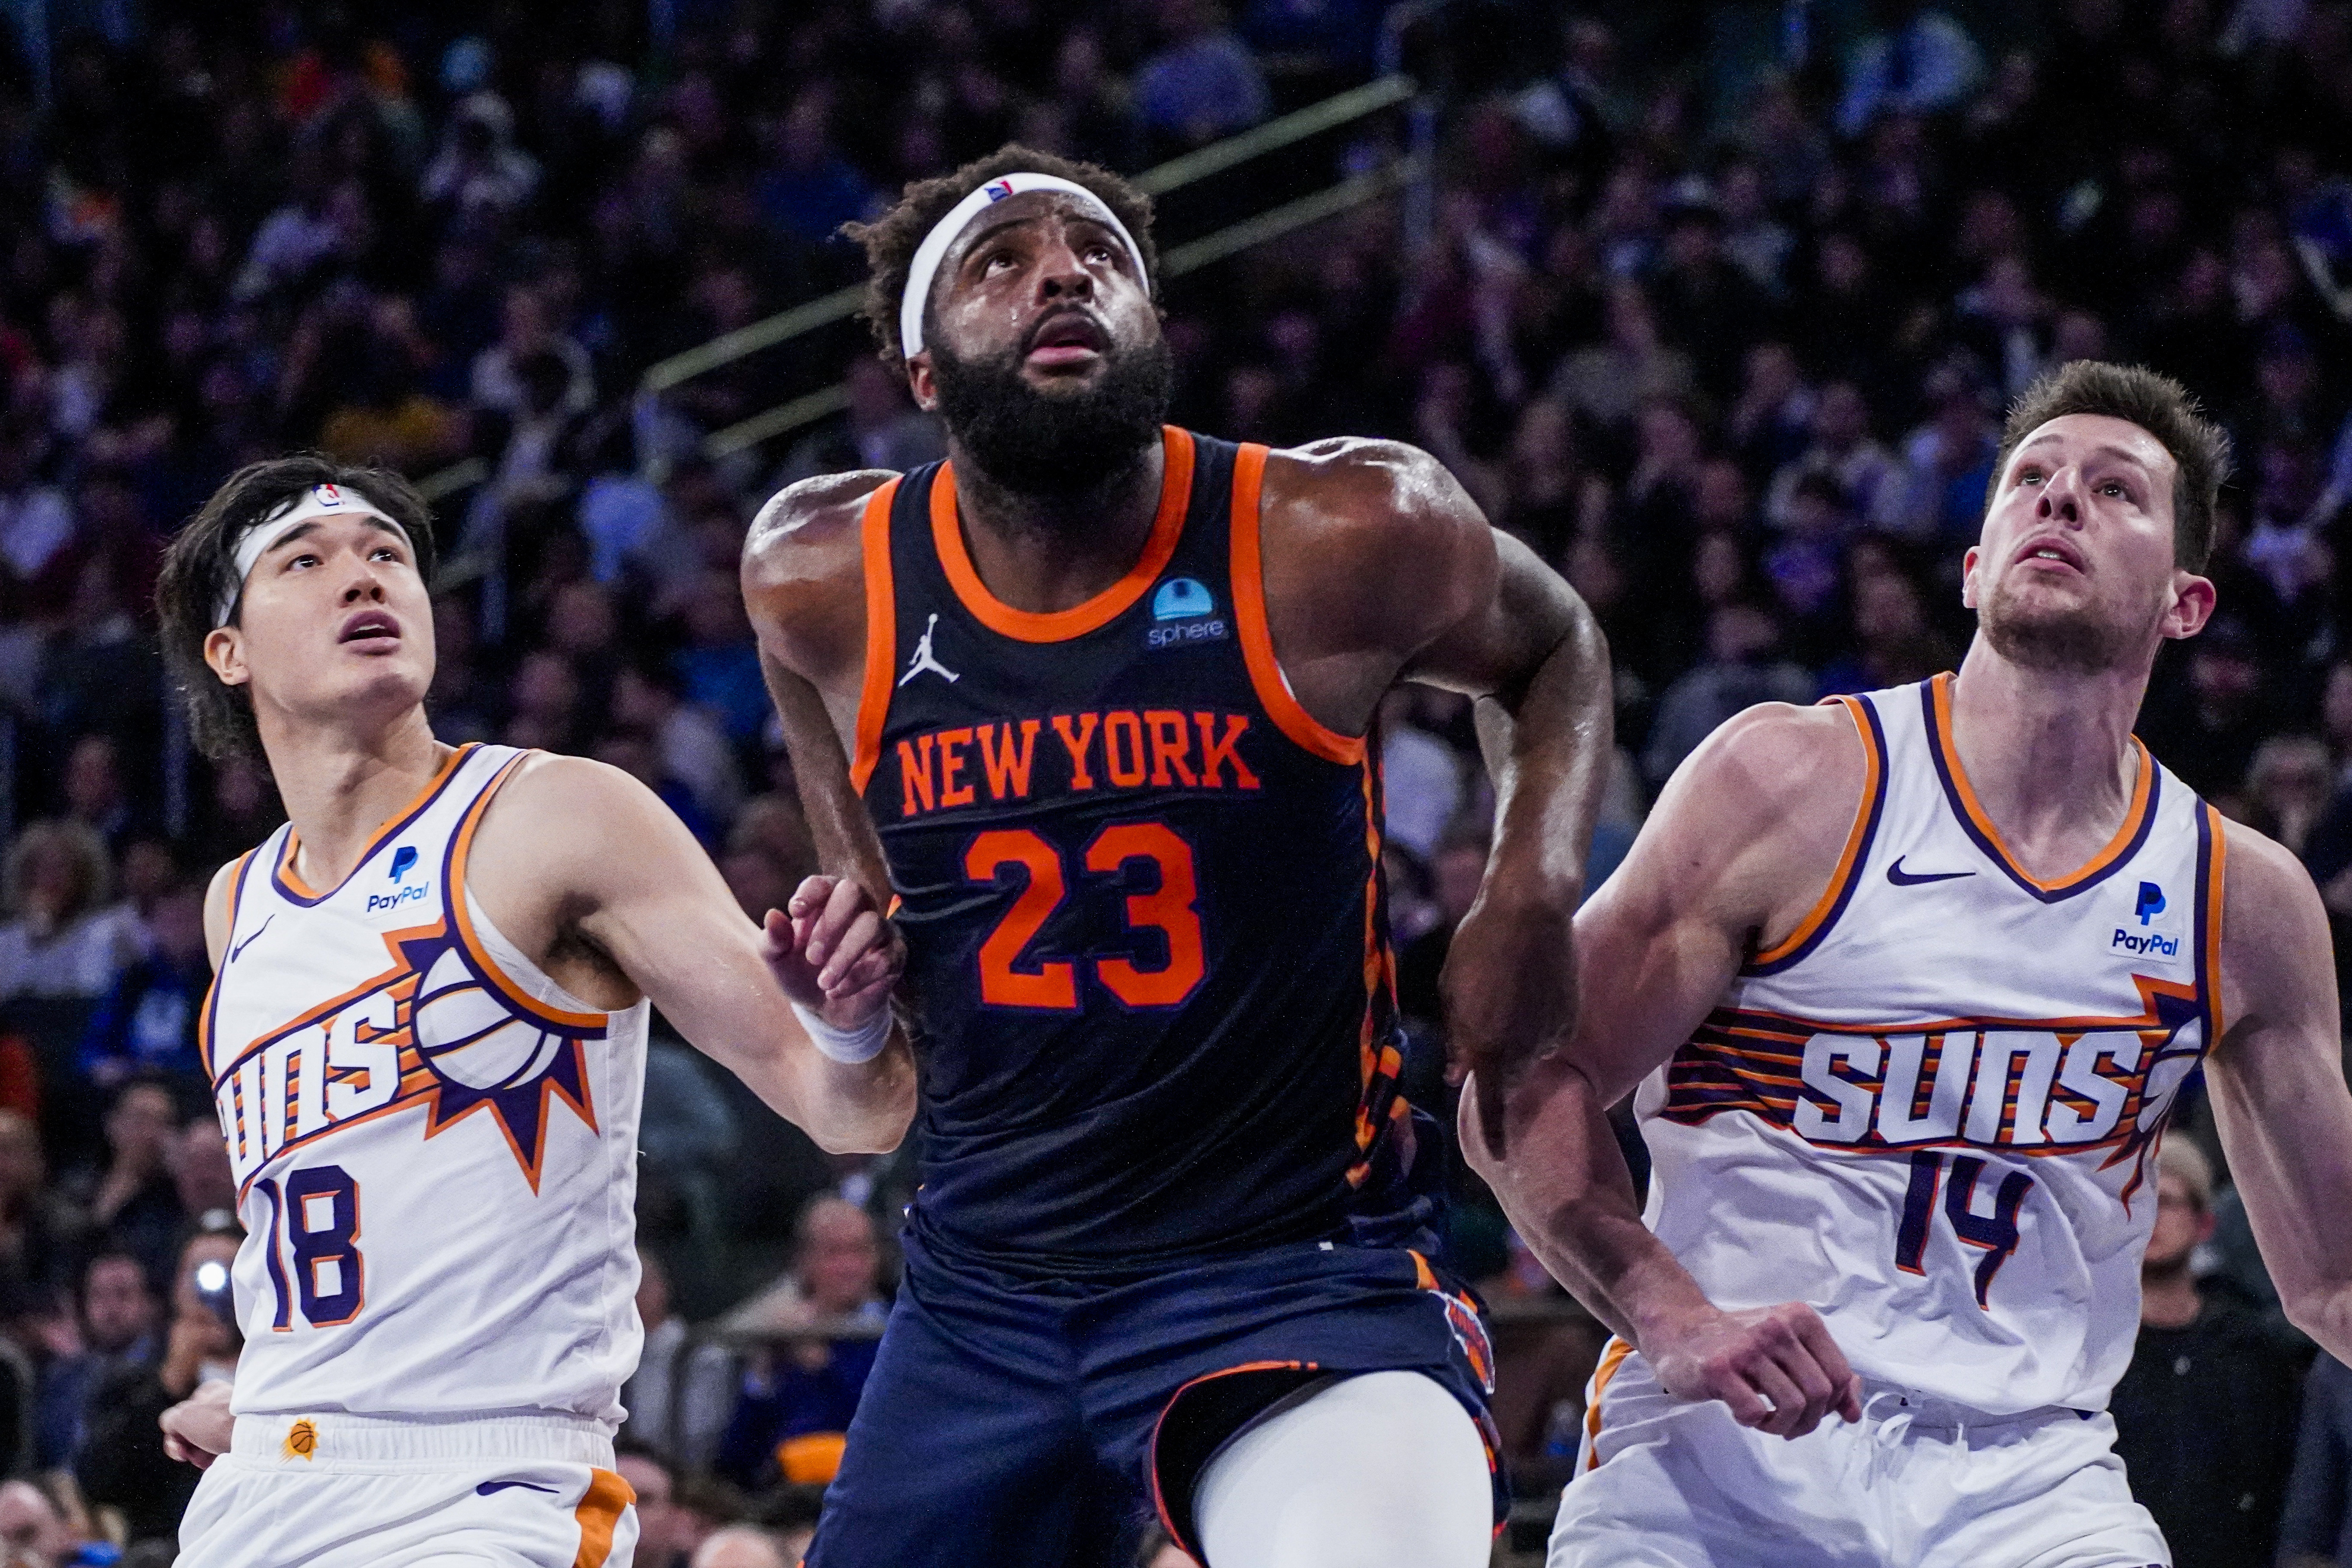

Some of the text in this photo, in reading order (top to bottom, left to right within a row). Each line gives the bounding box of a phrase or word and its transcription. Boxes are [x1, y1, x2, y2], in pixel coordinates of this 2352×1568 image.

[1149, 620, 1224, 646] sphere
[896, 710, 1261, 817] NEW YORK
[367, 881, 430, 913] PayPal
[964, 822, 1205, 1009] 23
[2112, 928, 2179, 956] PayPal
[216, 989, 399, 1190] UNS
[1791, 1030, 2143, 1145] SUNS
[253, 1164, 365, 1332] 18
[1895, 1149, 2035, 1312] 14
